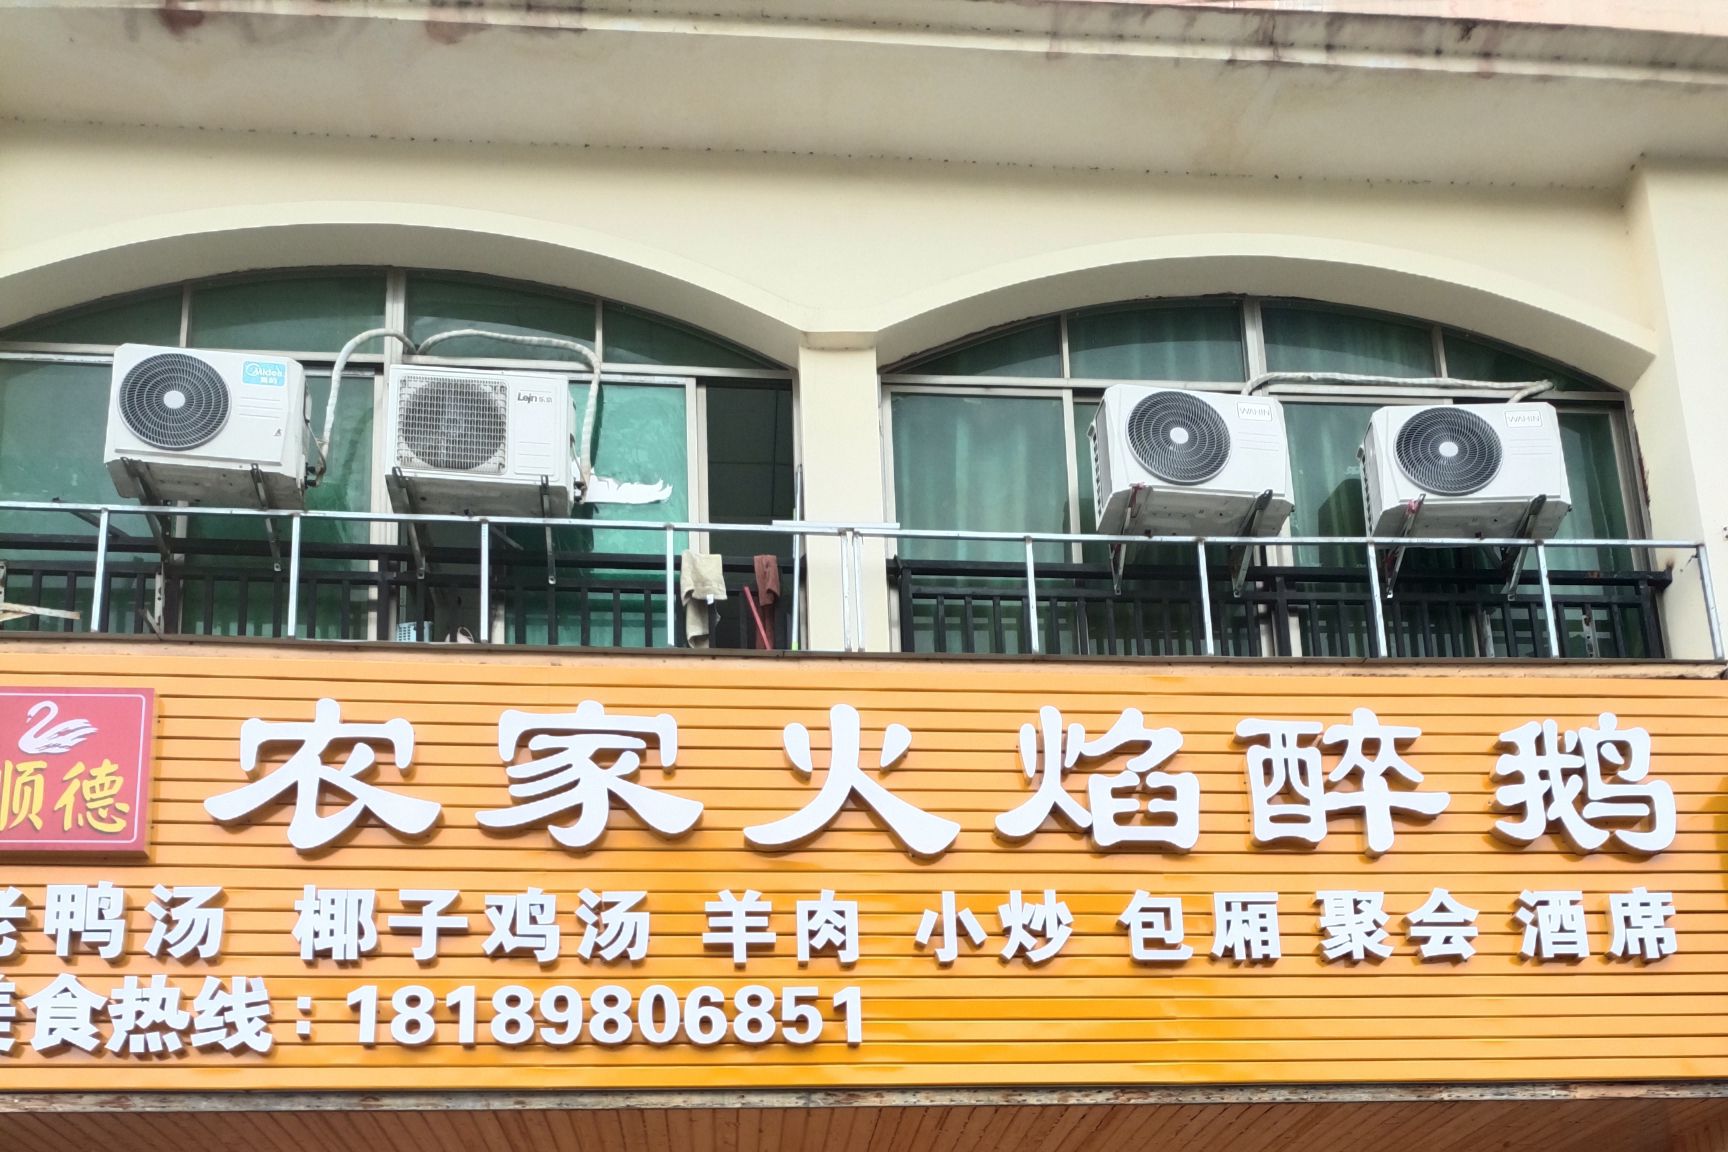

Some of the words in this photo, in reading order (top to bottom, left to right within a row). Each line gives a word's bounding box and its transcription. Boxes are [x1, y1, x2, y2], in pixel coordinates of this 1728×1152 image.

[0, 758, 130, 832] 顺德
[204, 697, 1677, 858] 农家火焰醉鹅
[292, 886, 650, 963] 椰子鸡汤
[703, 889, 860, 964] 羊肉
[915, 889, 1075, 966] 小炒
[1119, 890, 1281, 962] 包厢
[1316, 888, 1479, 962] 聚会
[1516, 887, 1677, 961] 酒席
[0, 973, 863, 1054] 食热线:18189806851
